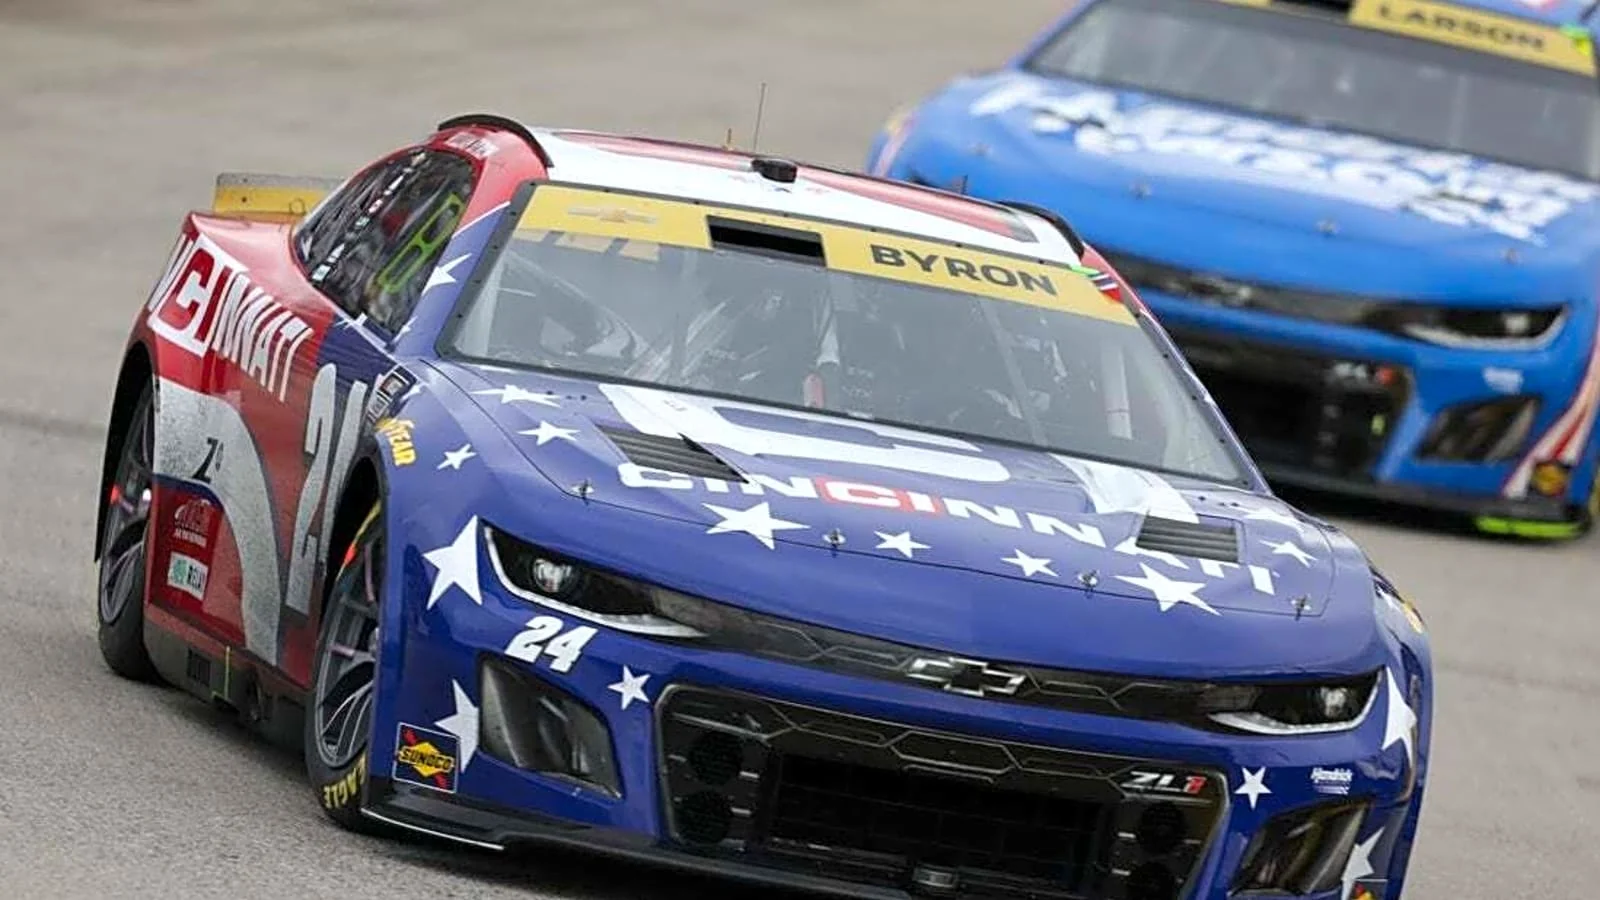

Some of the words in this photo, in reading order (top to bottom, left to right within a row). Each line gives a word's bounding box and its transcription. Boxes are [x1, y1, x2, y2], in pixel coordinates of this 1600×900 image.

[1379, 5, 1545, 51] LARSON
[870, 243, 1058, 297] BYRON
[504, 615, 598, 673] 24
[323, 752, 367, 810] EAGLE
[400, 747, 452, 771] SUNOCO
[1120, 770, 1208, 795] ZL1
